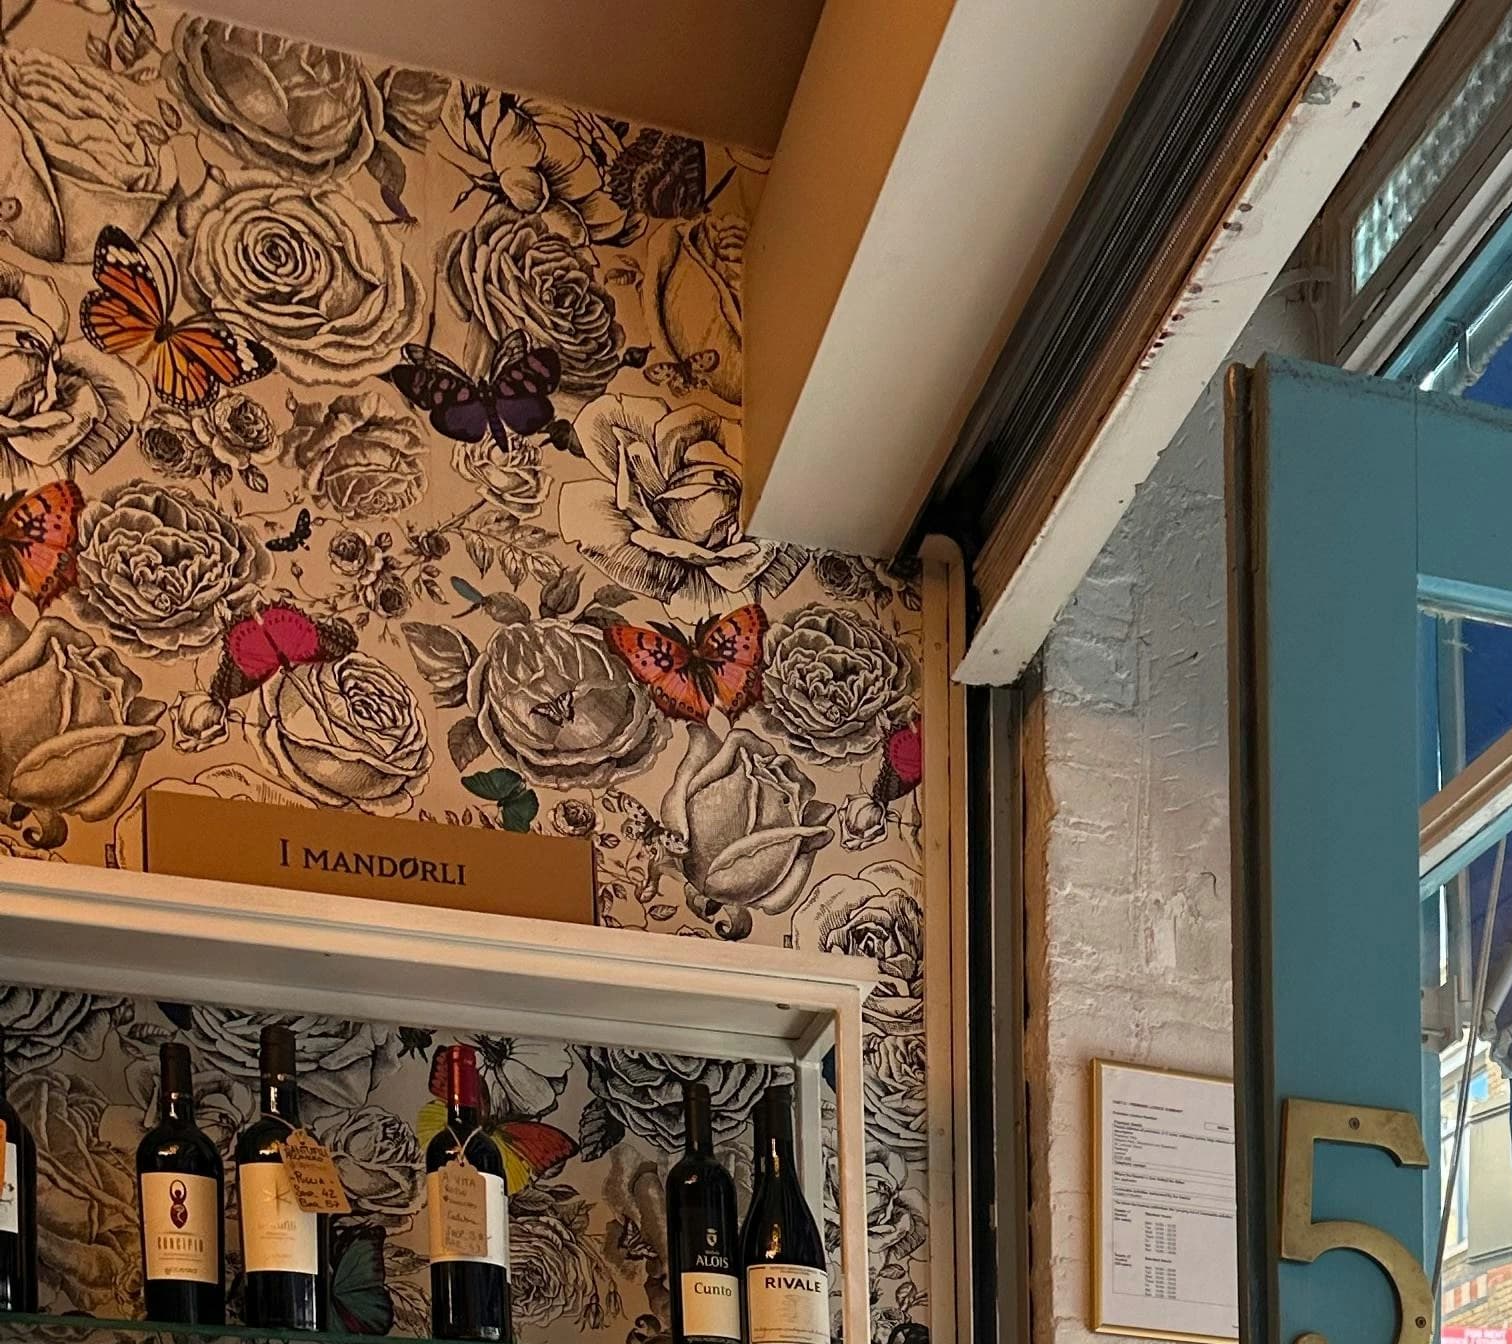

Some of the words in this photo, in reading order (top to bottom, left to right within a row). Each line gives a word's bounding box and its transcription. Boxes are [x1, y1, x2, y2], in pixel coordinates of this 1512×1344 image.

[280, 839, 290, 867] I
[303, 846, 467, 886] MANDORLI
[696, 1256, 729, 1269] ALOIS
[694, 1281, 732, 1297] Cunto
[765, 1276, 822, 1293] RIVALE
